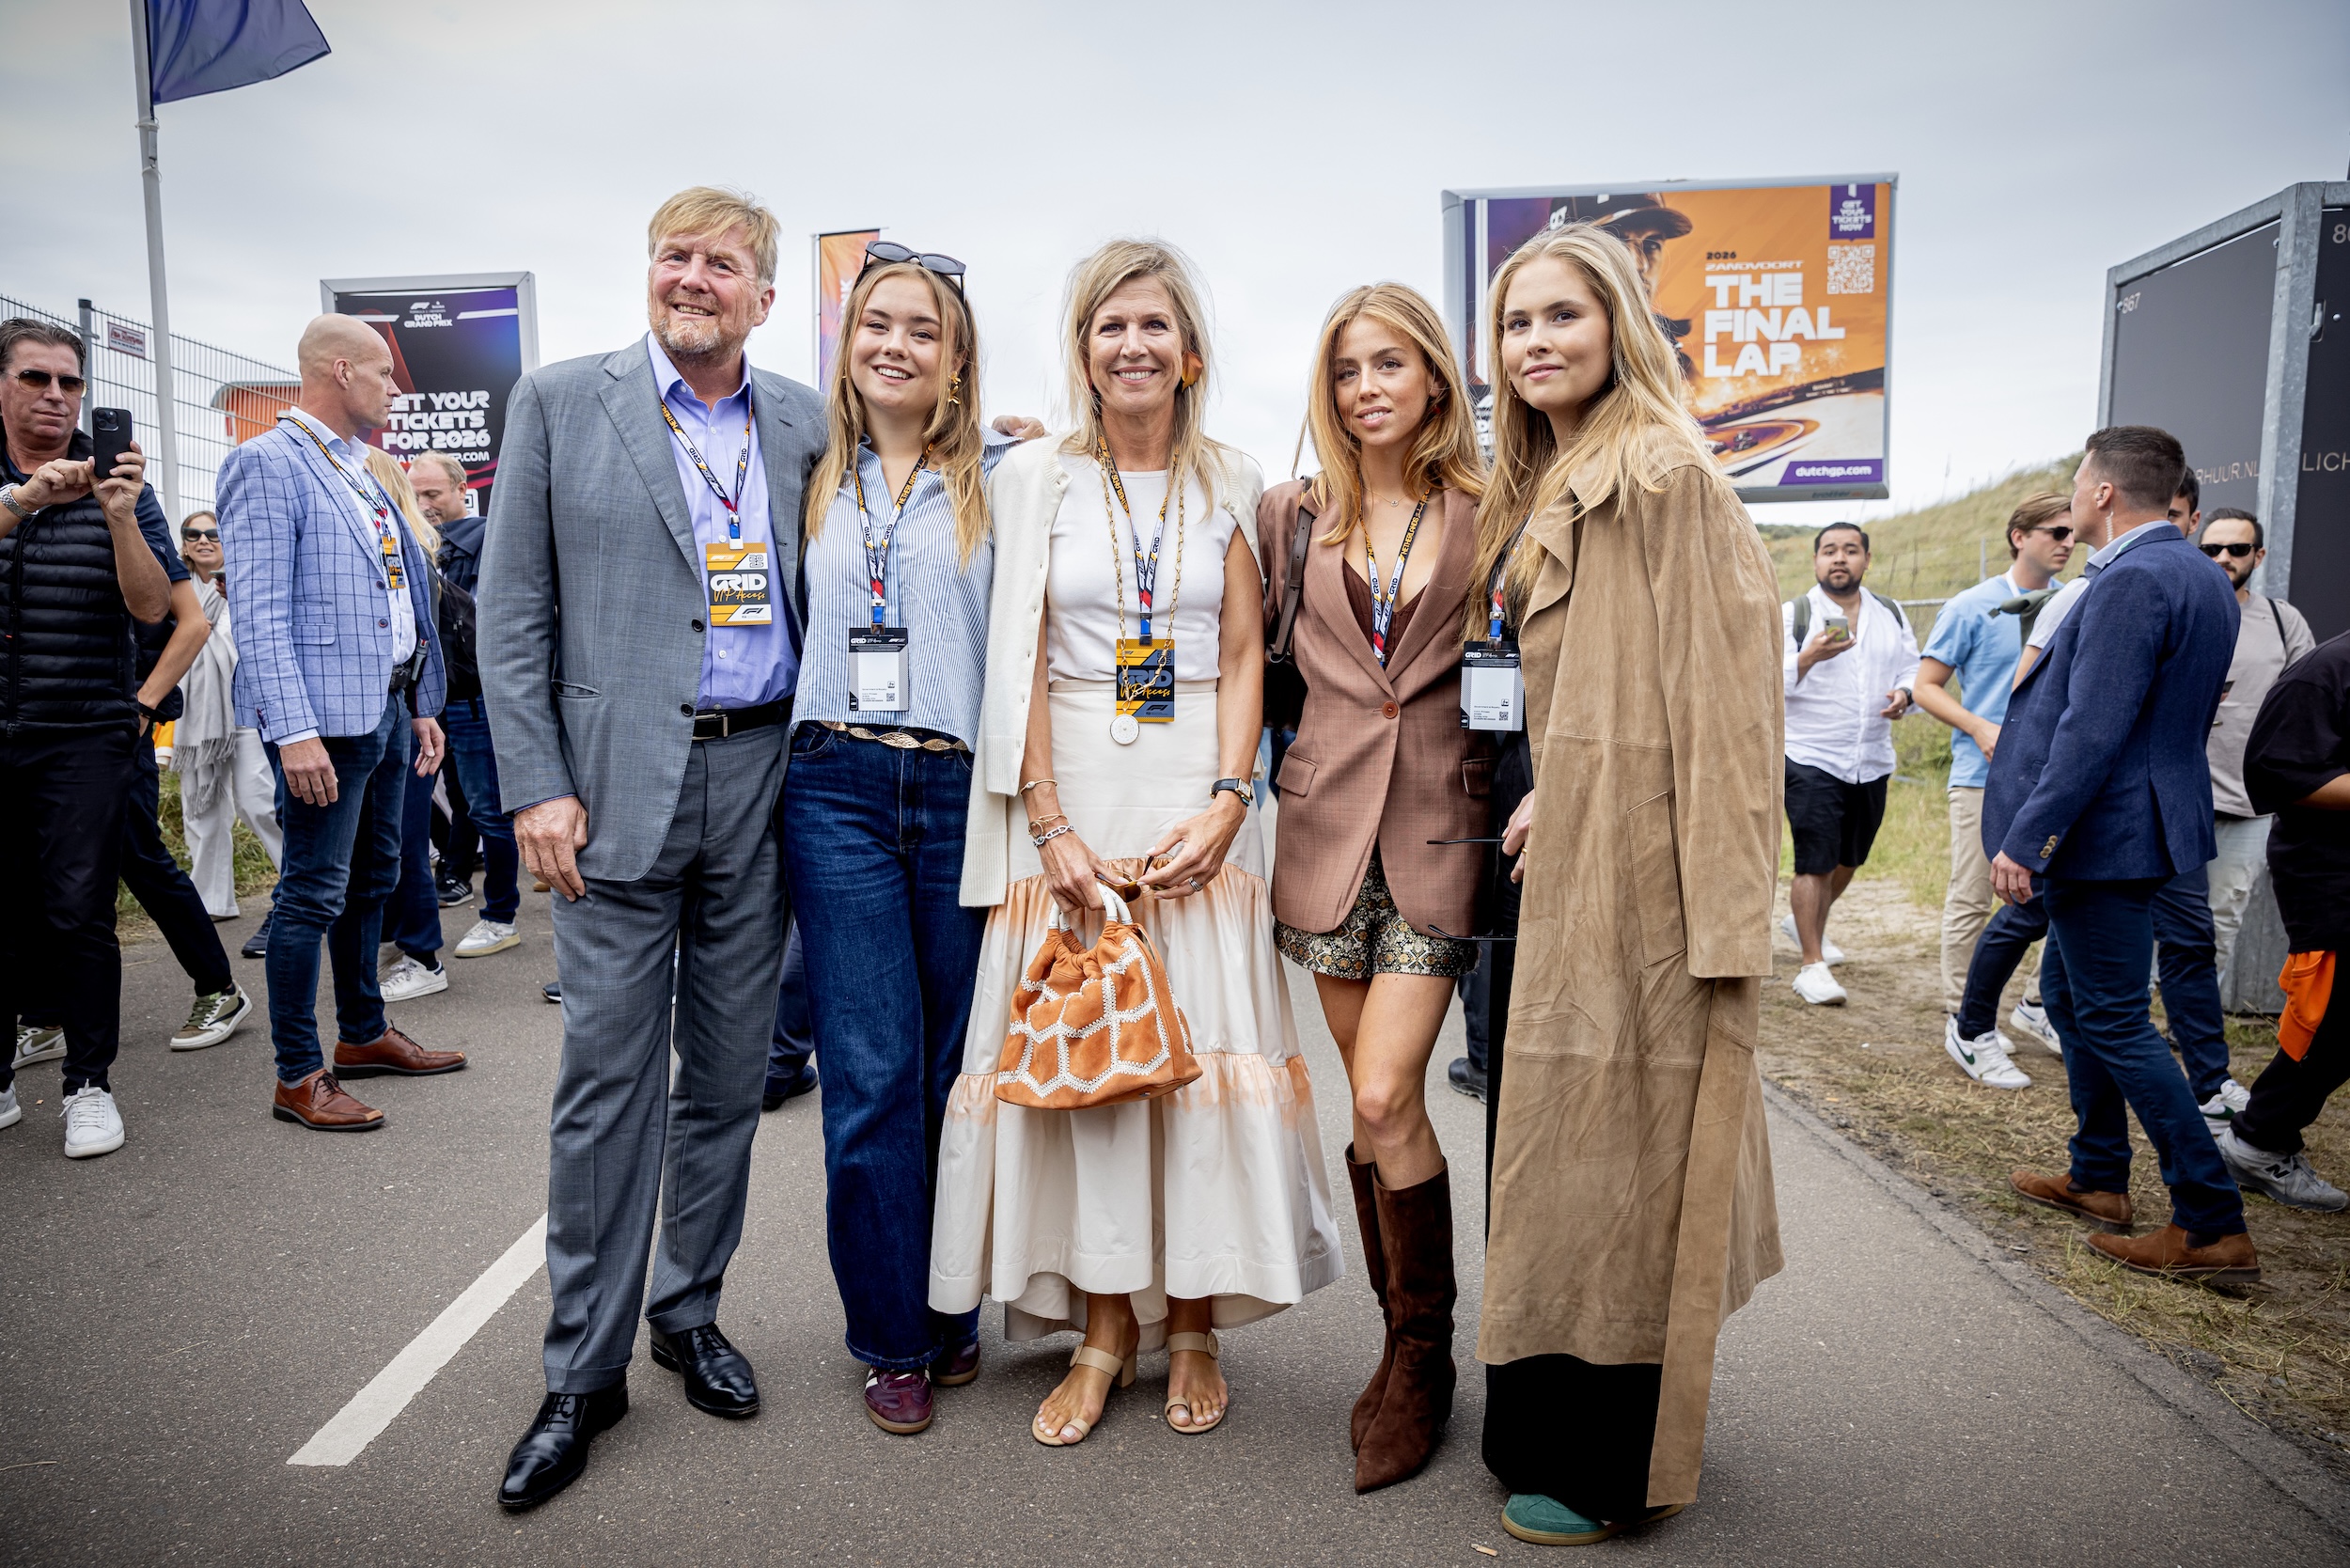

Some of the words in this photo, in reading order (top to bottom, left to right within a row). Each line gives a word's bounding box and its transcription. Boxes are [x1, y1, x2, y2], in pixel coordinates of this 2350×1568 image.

[2332, 223, 2350, 244] 8
[1706, 251, 1737, 260] 2026
[1705, 260, 1804, 271] ZANDVOORT
[1705, 273, 1803, 308] THE
[2122, 291, 2141, 314] 867
[414, 313, 442, 321] DUTCH
[433, 319, 453, 327] PRIX
[1704, 306, 1846, 343] FINAL
[1704, 341, 1802, 378] LAP
[391, 393, 426, 412] ET
[428, 390, 491, 411] YOUR
[387, 410, 486, 431] TICKETS
[382, 431, 430, 450] FOR
[431, 429, 491, 449] 2026
[689, 447, 702, 463] GRID
[1795, 465, 1872, 478] dutchgp.com
[884, 524, 893, 541] GRID
[898, 470, 918, 506] NETHERLANDS
[1152, 537, 1160, 554] GRID
[1388, 577, 1398, 595] GRID
[1401, 516, 1419, 556] NETHERLANDS
[710, 572, 767, 591] GRID
[1371, 577, 1380, 594] GRID
[735, 587, 765, 604] Access
[1118, 669, 1173, 687] GRID
